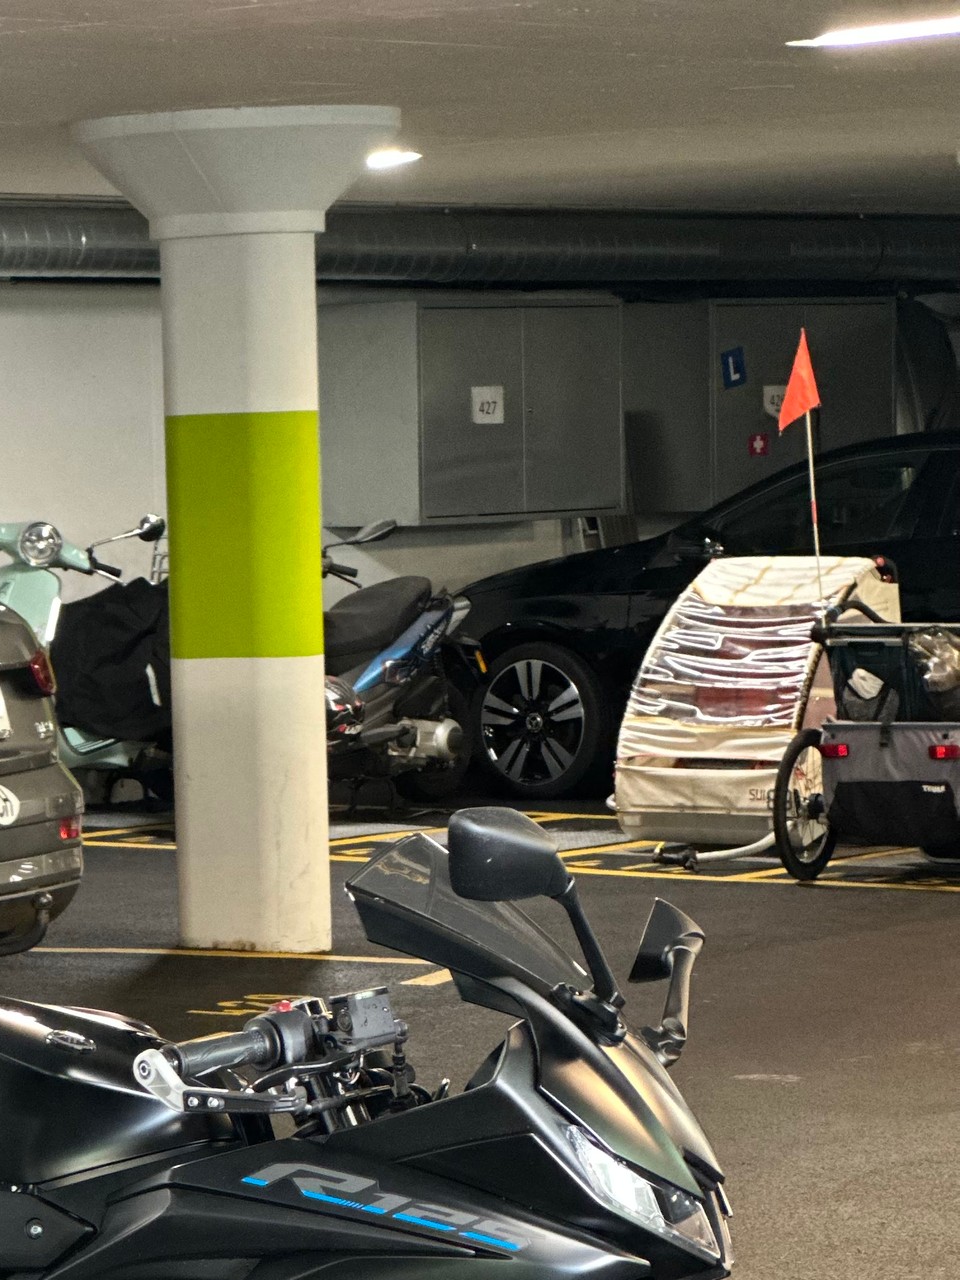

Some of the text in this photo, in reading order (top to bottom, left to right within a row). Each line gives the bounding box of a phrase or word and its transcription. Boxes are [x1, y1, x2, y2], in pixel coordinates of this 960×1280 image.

[729, 356, 740, 381] L
[479, 401, 497, 414] 427
[241, 1162, 543, 1250] R125
